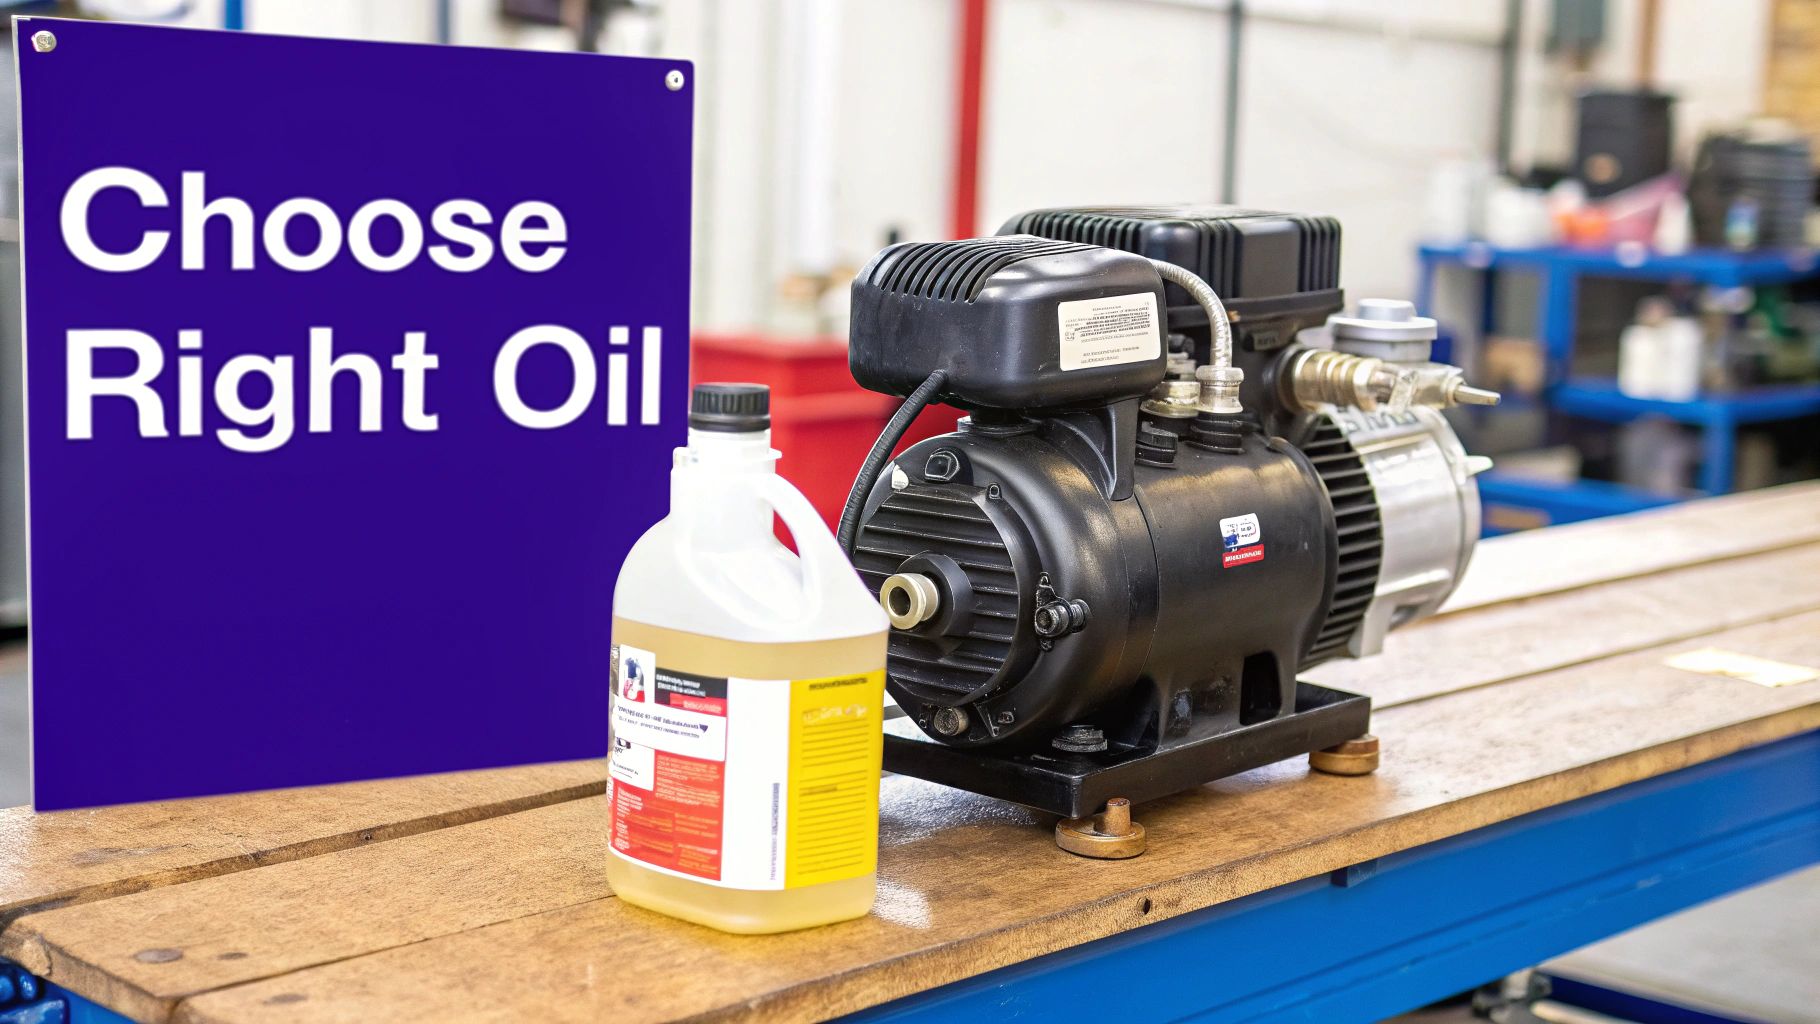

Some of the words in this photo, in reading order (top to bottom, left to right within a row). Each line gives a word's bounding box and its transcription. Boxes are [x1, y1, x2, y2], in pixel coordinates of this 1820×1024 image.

[59, 165, 568, 273] Choose
[65, 326, 440, 454] Right
[493, 324, 663, 430] Oil
